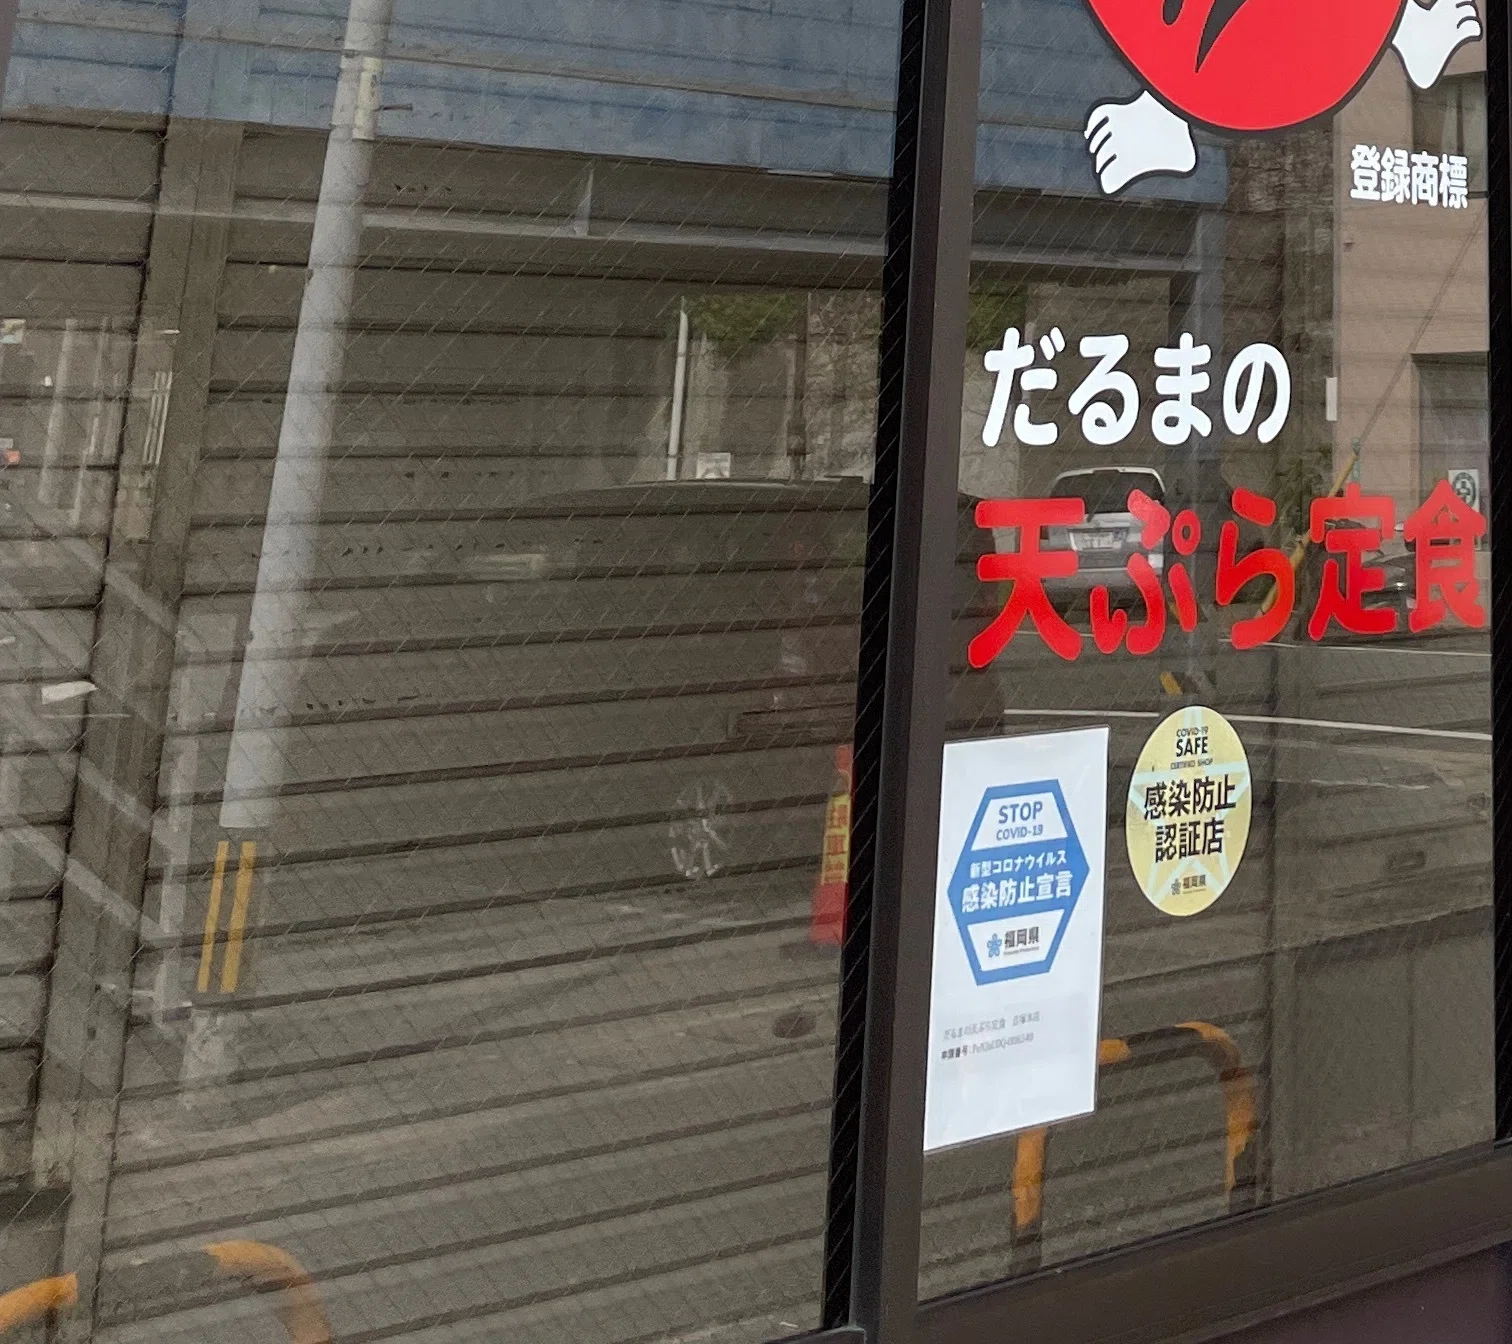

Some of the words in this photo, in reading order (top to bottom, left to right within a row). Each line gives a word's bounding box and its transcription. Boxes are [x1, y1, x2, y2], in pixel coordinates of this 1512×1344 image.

[1350, 144, 1469, 209] 登録商標
[982, 327, 1291, 447] だるまの
[968, 479, 1487, 668] 天ぷら定食
[1176, 736, 1208, 757] SAFE
[998, 801, 1043, 824] STOP
[1144, 774, 1237, 820] 感染防止
[996, 824, 1043, 841] COVID-19
[1155, 817, 1225, 863] 認証店
[970, 850, 1067, 879] 新型コロナウイルス
[962, 870, 1073, 913] 感染防止宣言
[1005, 927, 1039, 948] 福岡県
